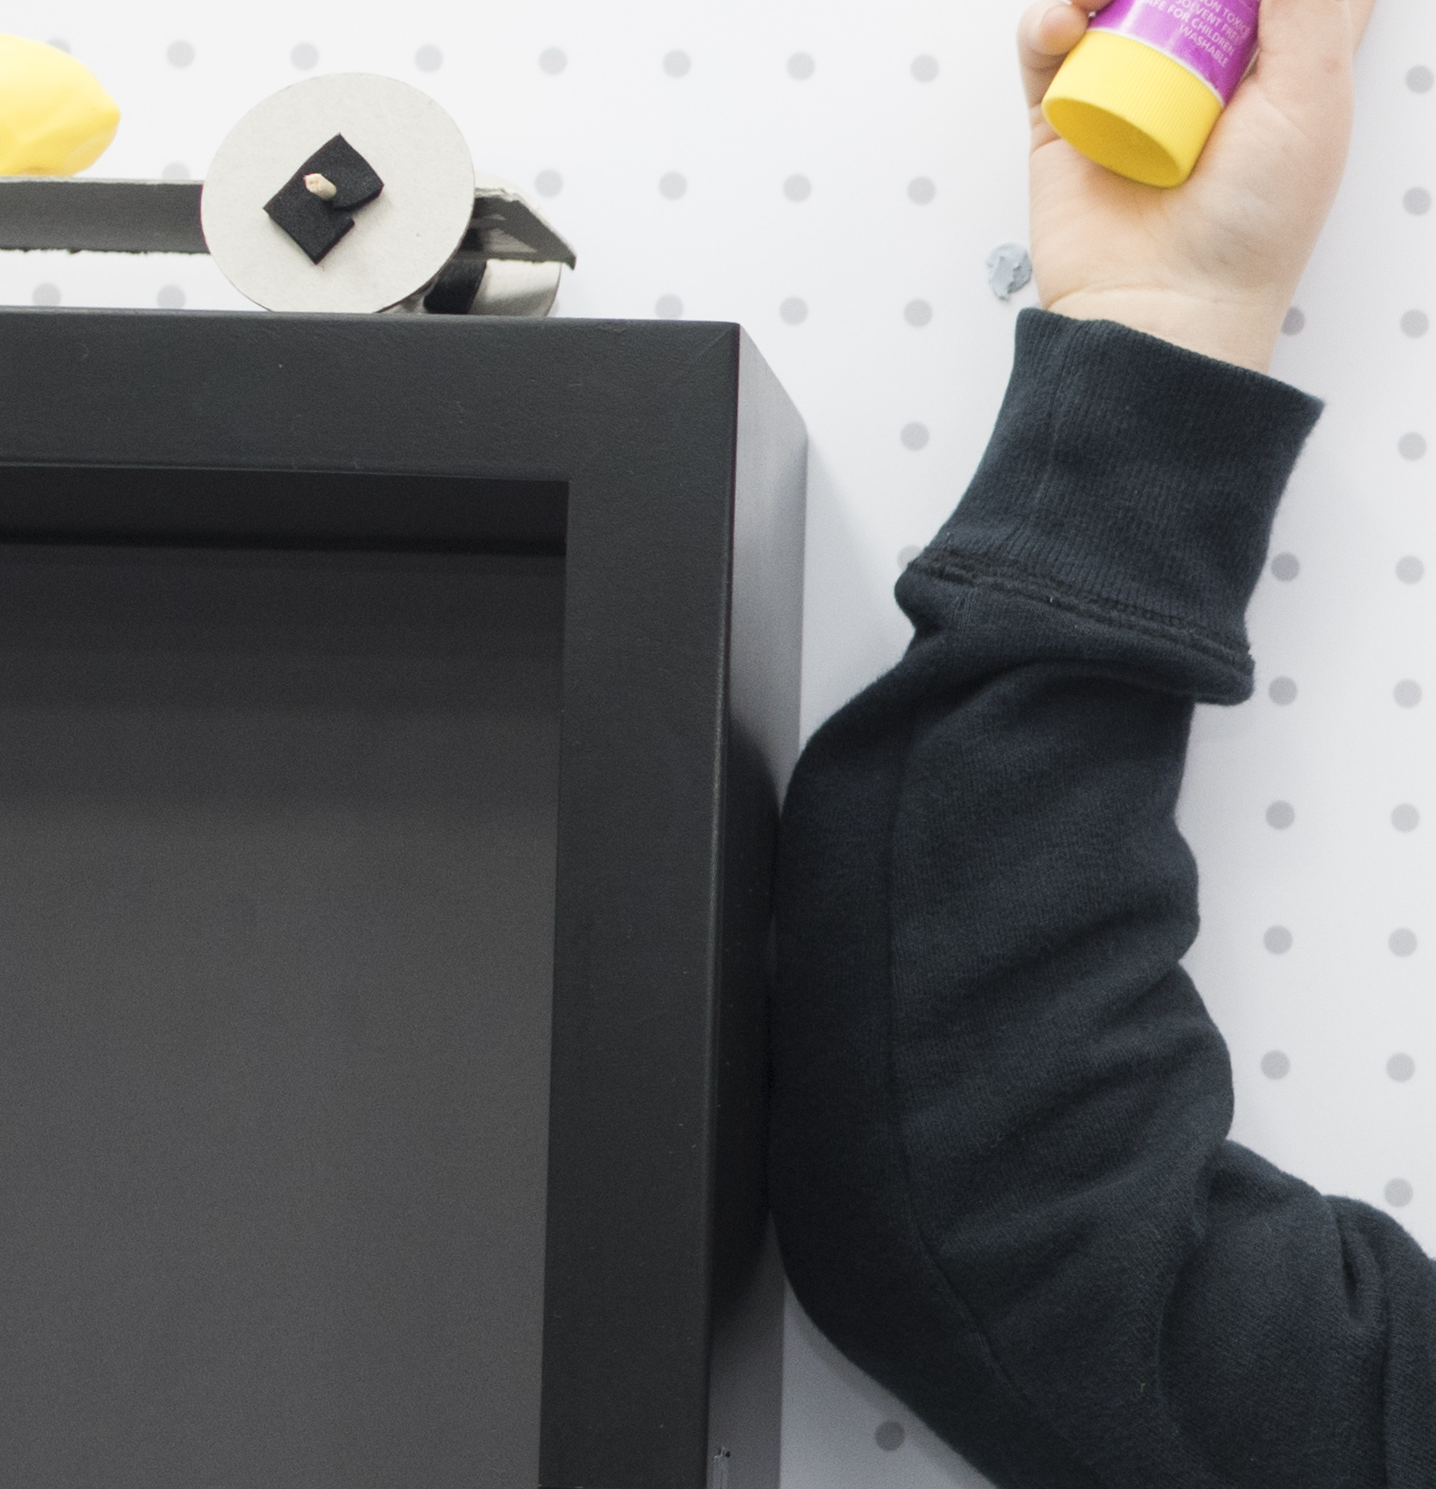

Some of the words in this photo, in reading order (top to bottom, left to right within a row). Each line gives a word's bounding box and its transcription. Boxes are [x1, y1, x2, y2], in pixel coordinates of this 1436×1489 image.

[1167, 5, 1191, 23] FOR
[1191, 17, 1235, 56] CHILDREN
[1179, 24, 1230, 67] WASHABLE
